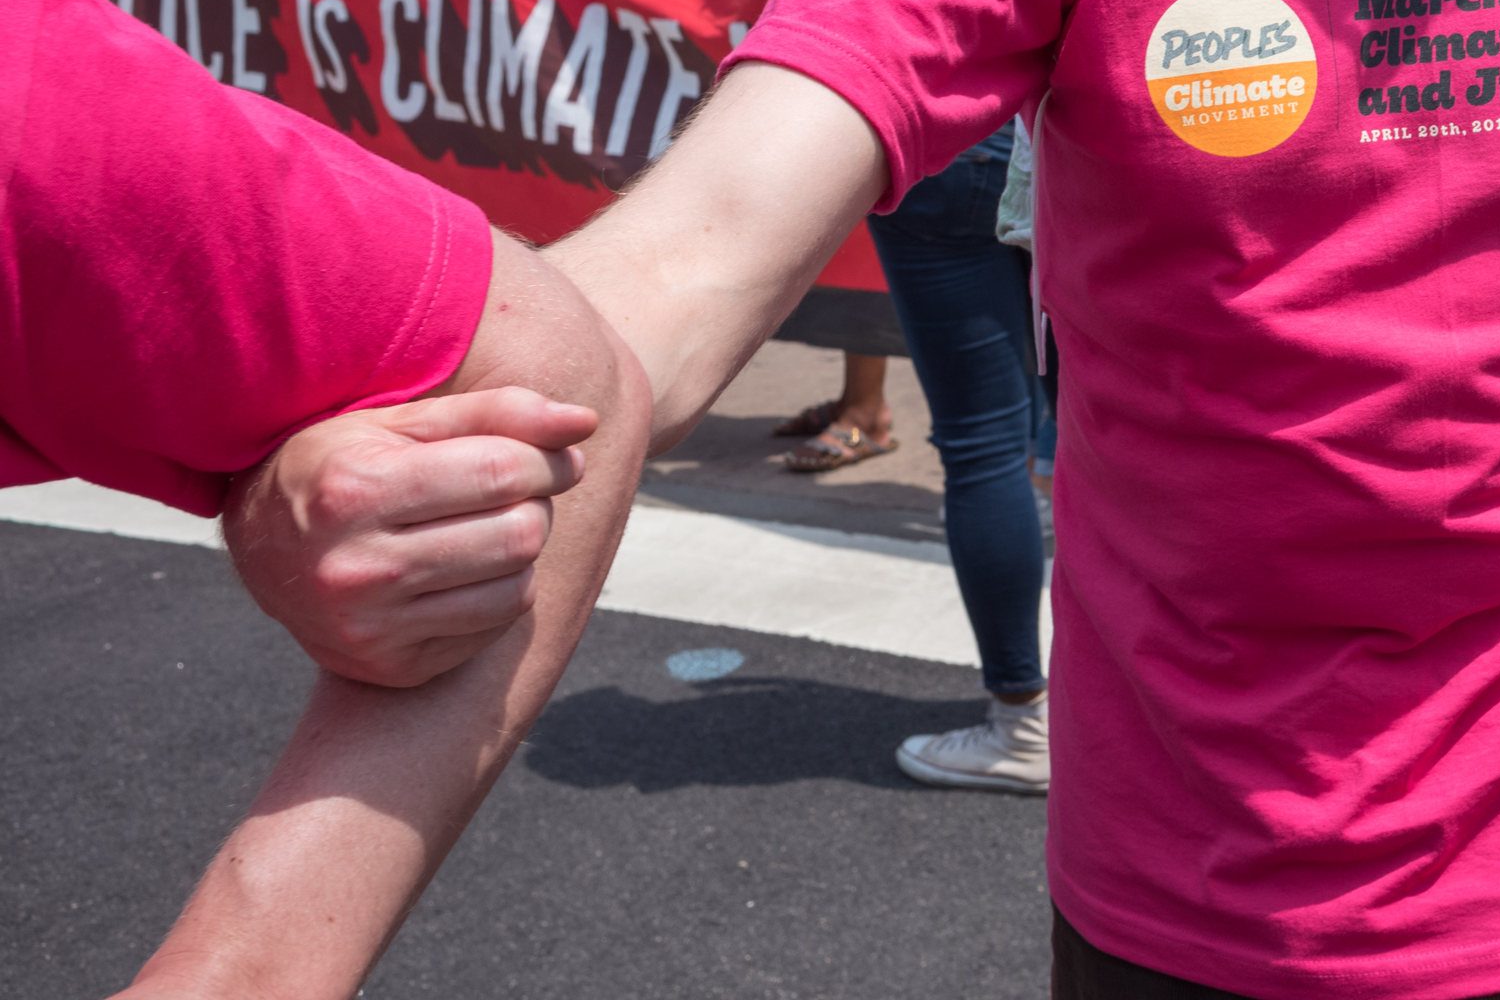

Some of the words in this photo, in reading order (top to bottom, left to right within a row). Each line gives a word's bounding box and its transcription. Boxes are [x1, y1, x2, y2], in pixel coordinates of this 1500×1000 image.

[1161, 19, 1298, 70] PEOPLES
[1164, 74, 1306, 112] Climate
[1358, 70, 1456, 116] and
[1181, 101, 1299, 127] MOVEMENT
[1359, 127, 1412, 143] APRIL
[1417, 122, 1467, 138] 29th,
